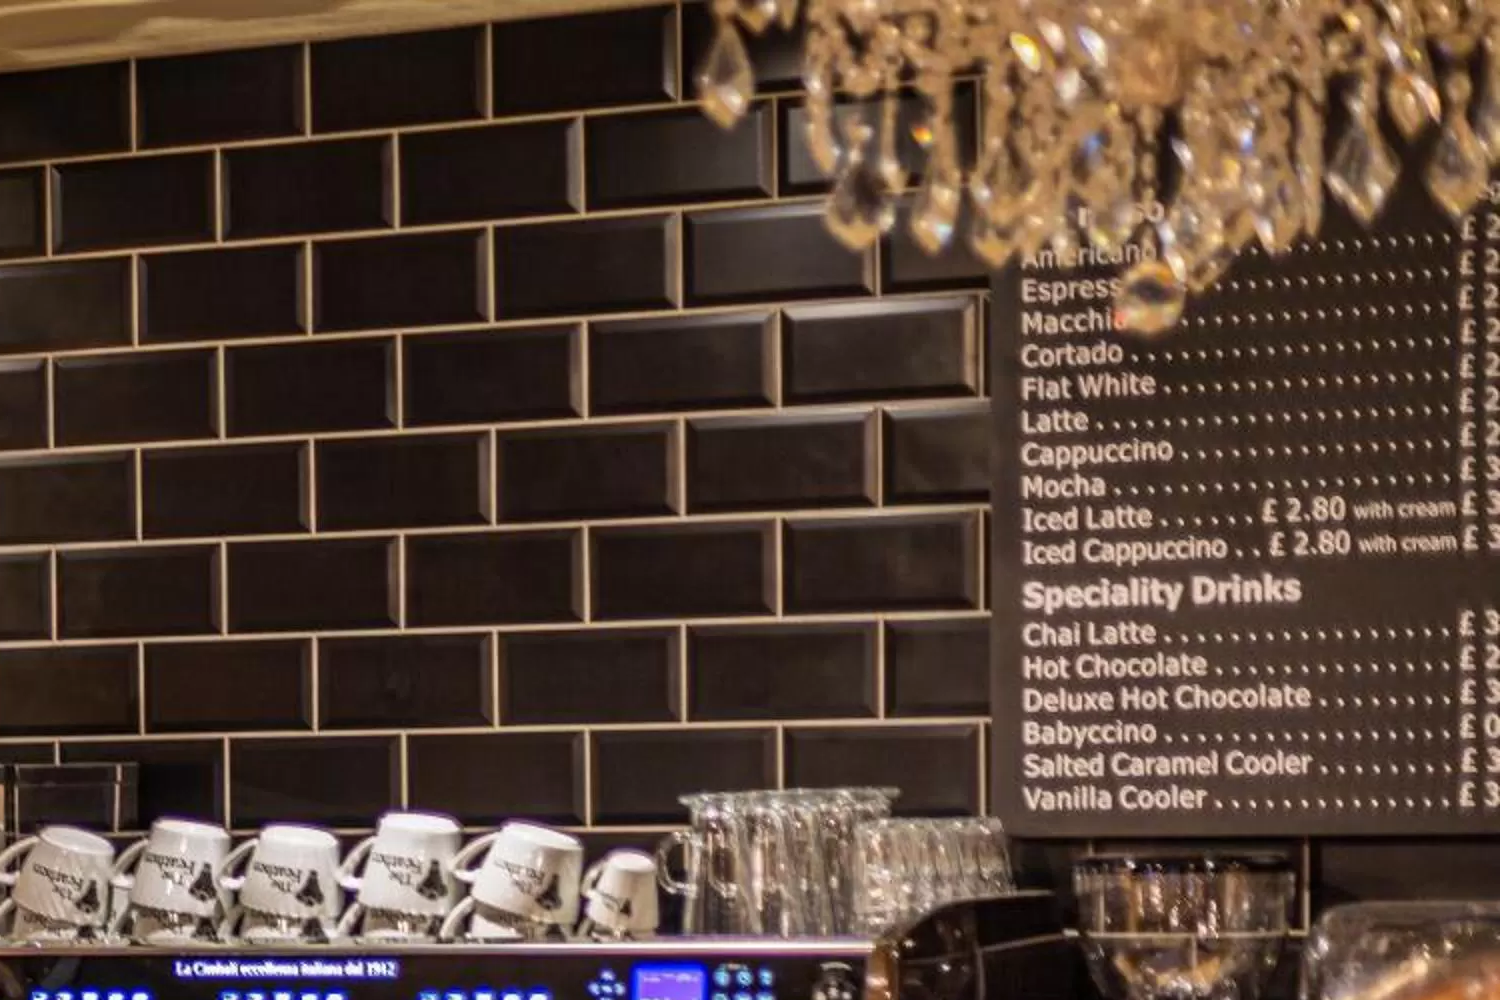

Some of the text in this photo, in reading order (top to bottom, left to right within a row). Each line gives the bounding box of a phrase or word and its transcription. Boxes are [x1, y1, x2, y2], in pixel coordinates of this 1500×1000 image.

[1021, 275, 1124, 304] Espress
[1021, 340, 1123, 368] Cortado
[1021, 374, 1072, 400] Flat
[1078, 372, 1156, 398] White
[1021, 409, 1089, 434] Latte
[1021, 438, 1174, 470] Cappuccino
[1021, 473, 1106, 499] Mocha
[1022, 505, 1078, 532] Iced
[1085, 505, 1153, 530] Latte
[1286, 495, 1346, 523] 2.80
[1353, 500, 1393, 520] with
[1397, 501, 1457, 519] cream
[1022, 539, 1077, 565] Iced
[1083, 535, 1228, 567] Cappuccino
[1293, 529, 1351, 556] 2.80
[1358, 534, 1397, 553] with
[1401, 534, 1458, 553] cream
[1022, 572, 1302, 615] Speciality Drinks
[1022, 622, 1081, 647] Chai
[1087, 621, 1156, 645] Latte
[1022, 655, 1071, 680] Hot
[1075, 652, 1208, 678] Chocolate
[1022, 687, 1114, 713] Deluxe
[1120, 686, 1169, 710] Hot
[1174, 683, 1312, 708] Chocolate
[1022, 720, 1157, 749] Babyccino
[1022, 752, 1105, 778] Salted
[1110, 750, 1219, 776] Caramel
[1224, 749, 1313, 775] Cooler
[1021, 785, 1113, 811] Vanilla
[1118, 784, 1208, 809] Cooler
